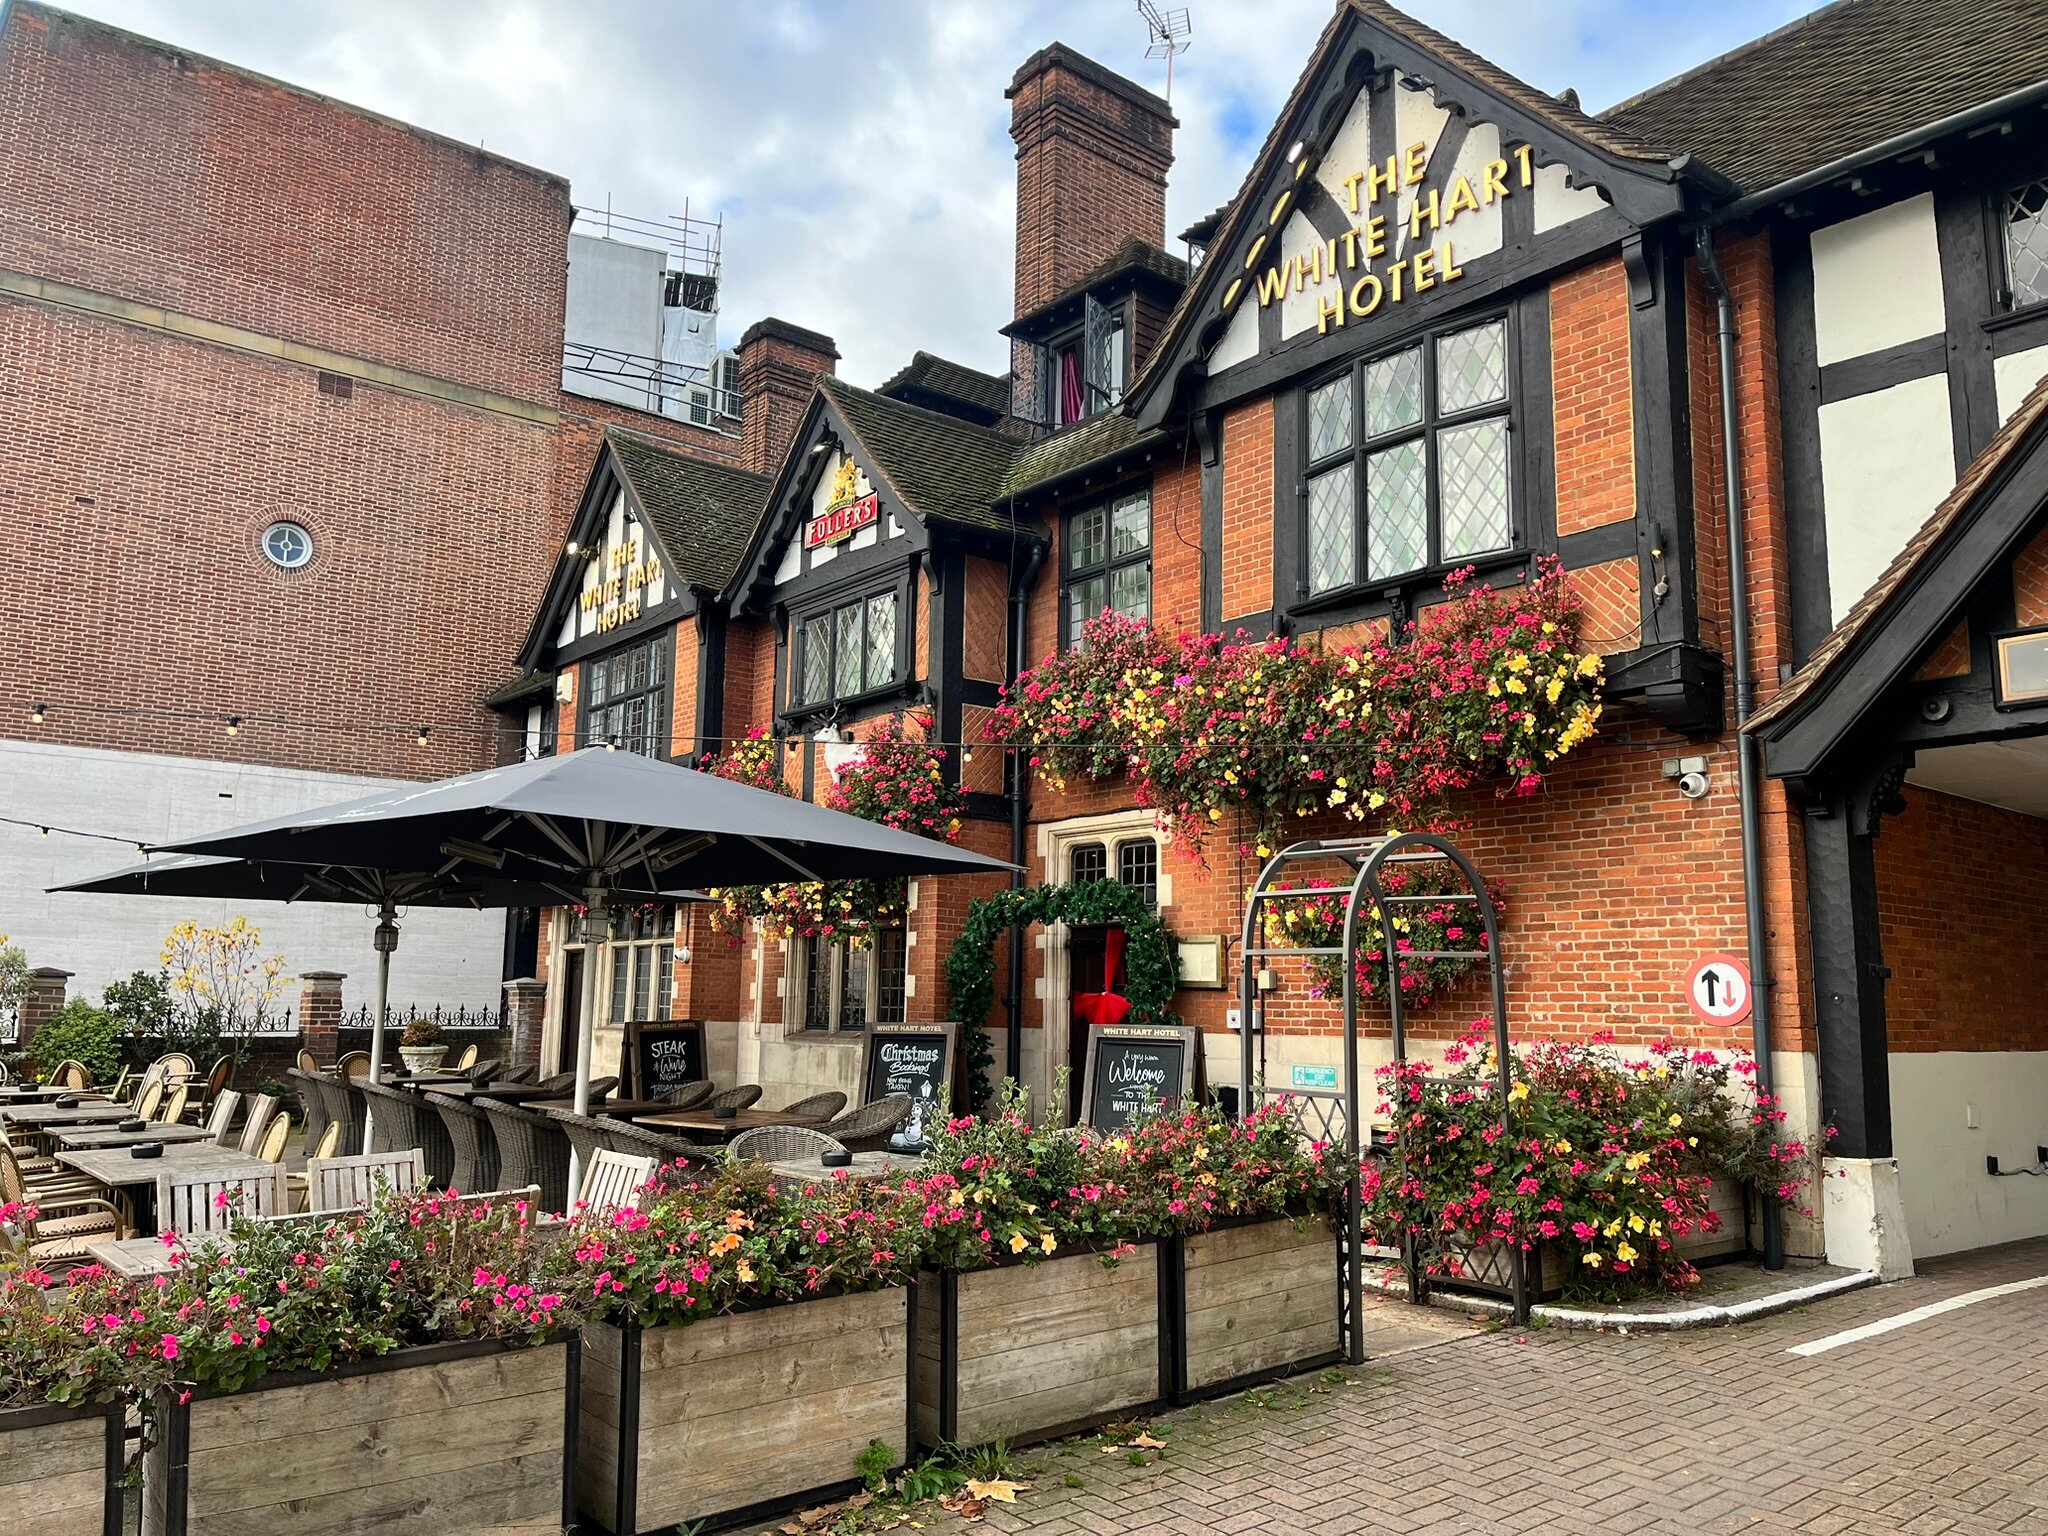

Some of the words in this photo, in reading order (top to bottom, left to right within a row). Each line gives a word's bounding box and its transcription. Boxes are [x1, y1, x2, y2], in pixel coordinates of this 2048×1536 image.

[1343, 140, 1426, 215] THE
[1256, 214, 1386, 308] WHITE
[1410, 143, 1535, 240] HART
[1317, 241, 1463, 335] HOTEL
[808, 500, 872, 544] FULLER'S
[611, 539, 636, 570] THE
[580, 576, 623, 613] WHITE
[628, 557, 663, 592] HART
[597, 597, 641, 635] HOTEL
[1130, 1028, 1152, 1036] HART
[1153, 1029, 1180, 1037] HOTEL
[651, 1040, 687, 1058] STEAK
[880, 1043, 940, 1062] Christmas
[660, 1057, 687, 1074] Wine
[660, 1071, 682, 1081] NIGHT
[888, 1061, 931, 1075] Bookings
[1108, 1059, 1166, 1084] Welcome
[1112, 1100, 1139, 1112] WHITE
[1124, 1091, 1134, 1099] TO
